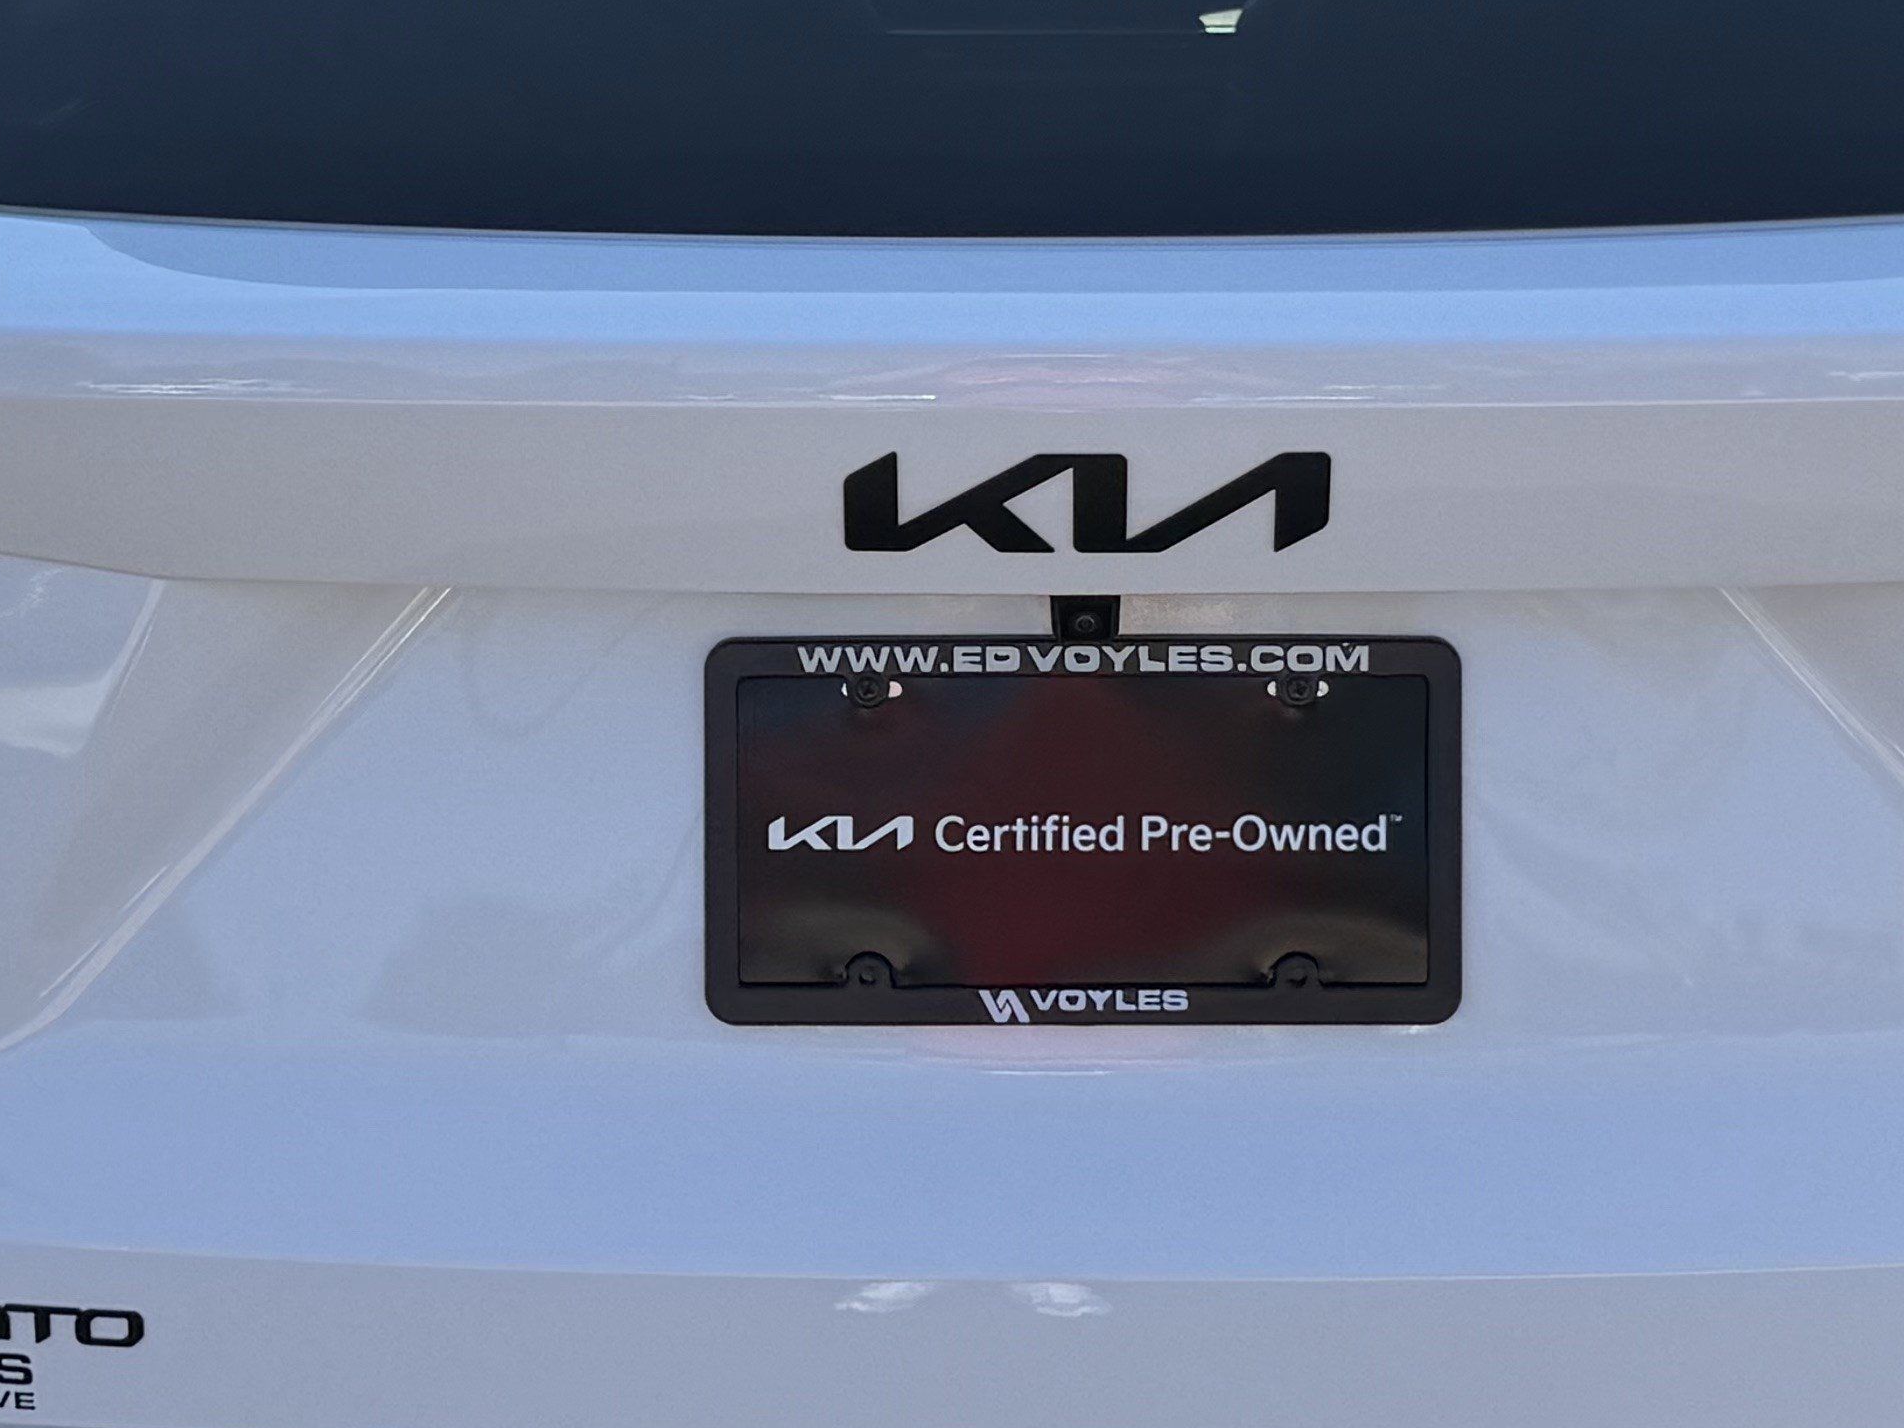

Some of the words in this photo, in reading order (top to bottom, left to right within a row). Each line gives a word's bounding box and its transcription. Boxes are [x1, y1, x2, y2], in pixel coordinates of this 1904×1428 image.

[843, 452, 1332, 553] KIA
[768, 815, 914, 851] KIA
[935, 814, 1125, 852] Certified
[1030, 989, 1189, 1012] VOYLES
